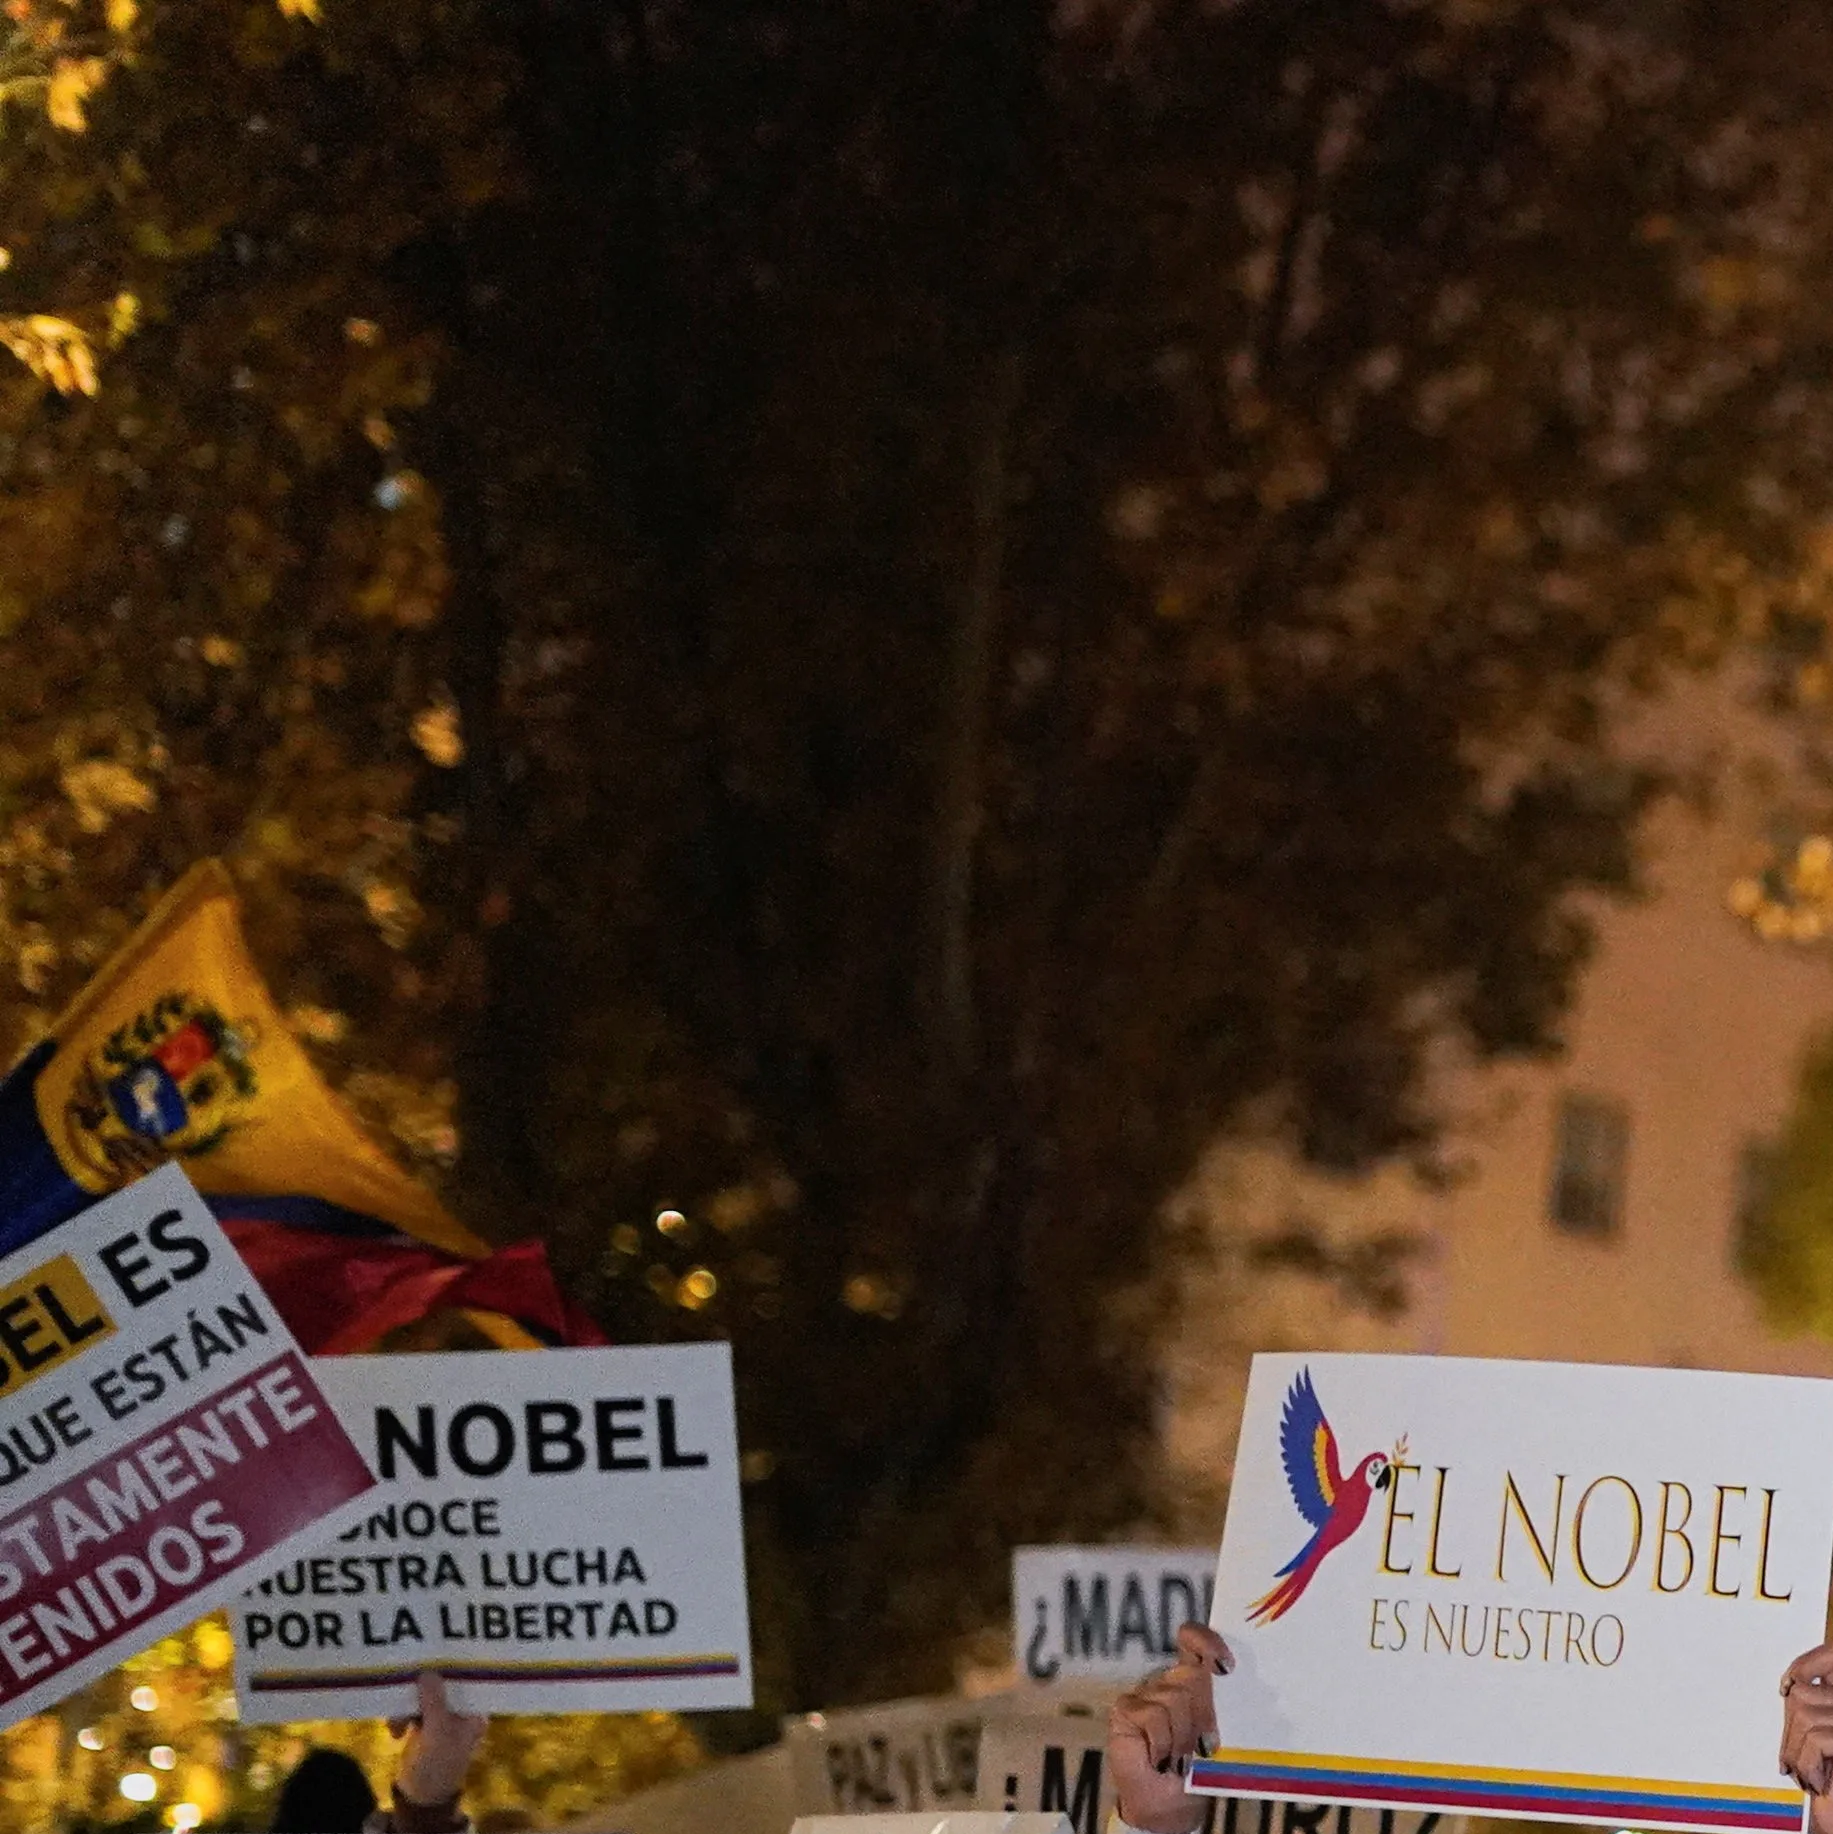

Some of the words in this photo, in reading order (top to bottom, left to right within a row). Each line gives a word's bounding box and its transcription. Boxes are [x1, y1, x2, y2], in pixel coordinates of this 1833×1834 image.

[0, 1284, 104, 1384] EL
[98, 1209, 210, 1308] ES
[89, 1293, 268, 1420] ESTÁN
[375, 1397, 709, 1478] NOBEL
[245, 1549, 465, 1598] UESTRA
[481, 1545, 647, 1589] LUCHA
[1377, 1464, 1462, 1578] EL
[1496, 1469, 1793, 1602] NOBEL
[246, 1610, 343, 1649] POR
[360, 1608, 423, 1646] LA
[440, 1599, 678, 1641] LIBERTAD
[1369, 1598, 1408, 1652] ES
[1423, 1601, 1625, 1666] NUESTRO
